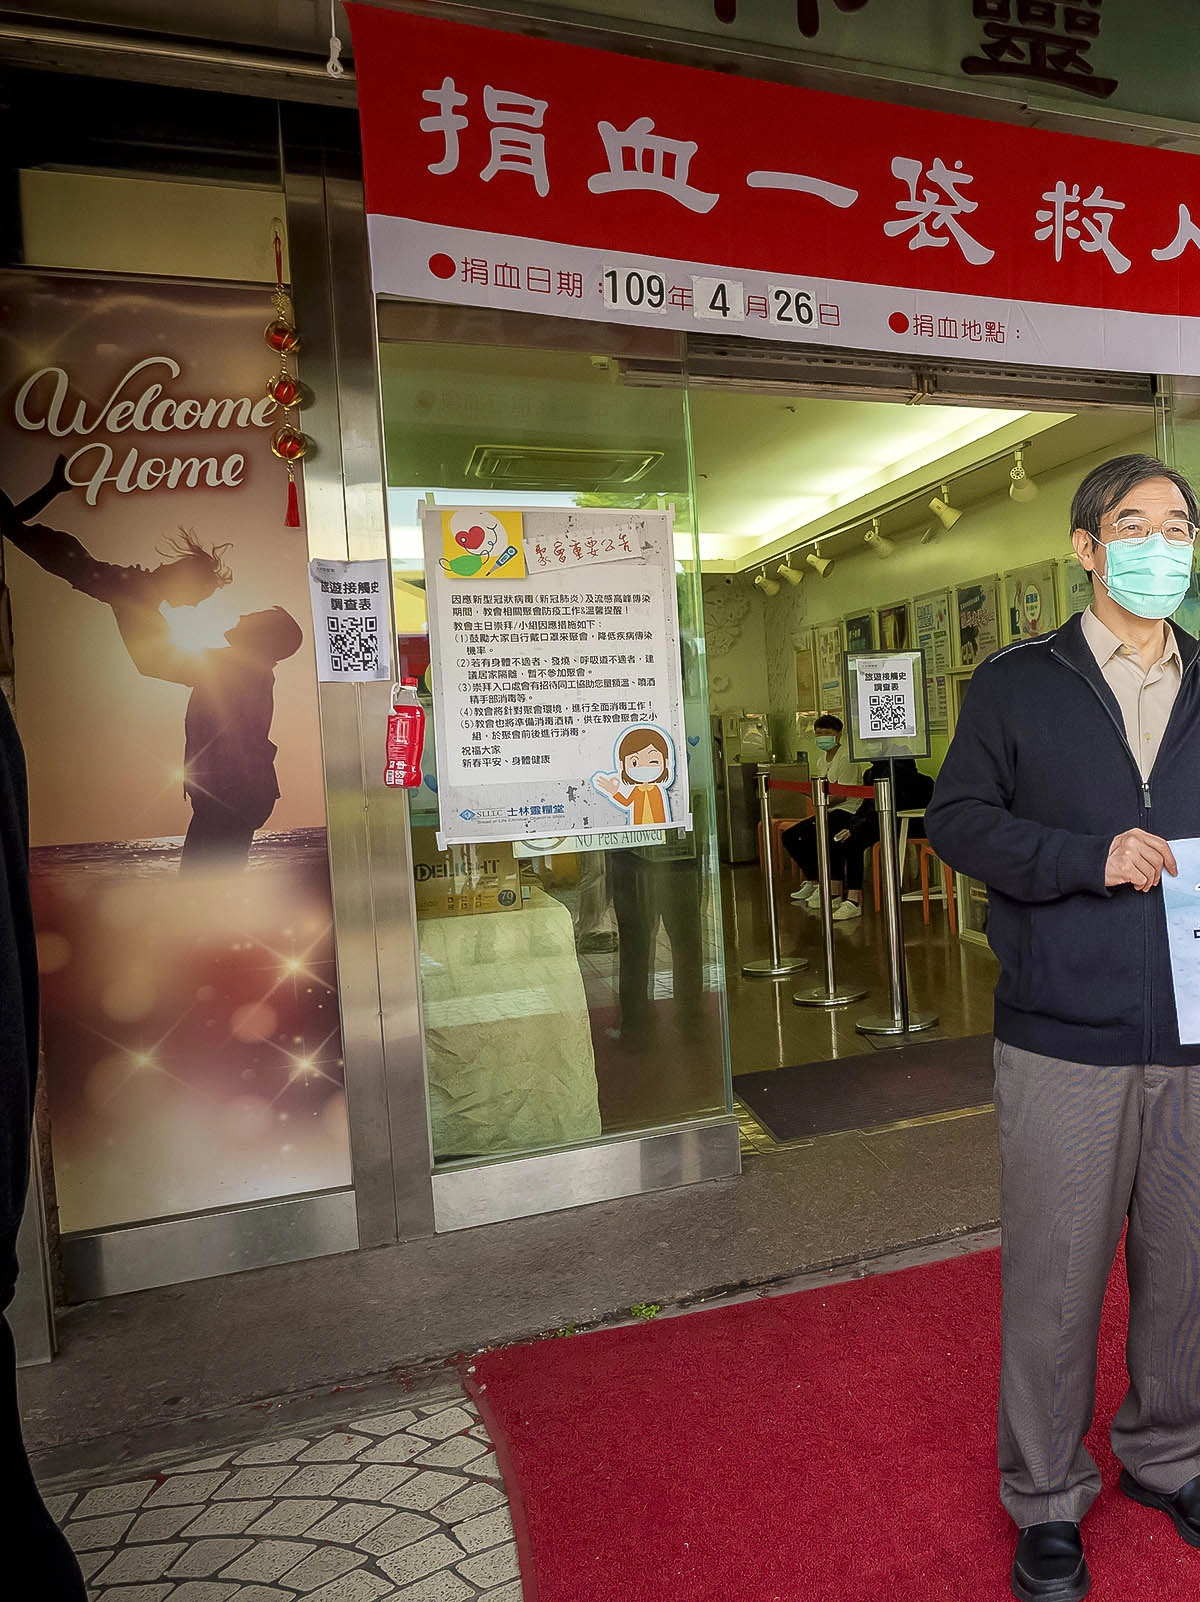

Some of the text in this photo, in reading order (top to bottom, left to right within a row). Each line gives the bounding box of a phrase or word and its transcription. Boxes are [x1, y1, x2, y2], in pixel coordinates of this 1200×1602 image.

[15, 356, 278, 437] Welcome
[64, 442, 245, 506] Home
[535, 533, 632, 566] 聚會重要公告
[330, 598, 371, 610] 調查表
[461, 745, 501, 756] 祝福大家
[507, 804, 565, 817] 士林靈糧堂
